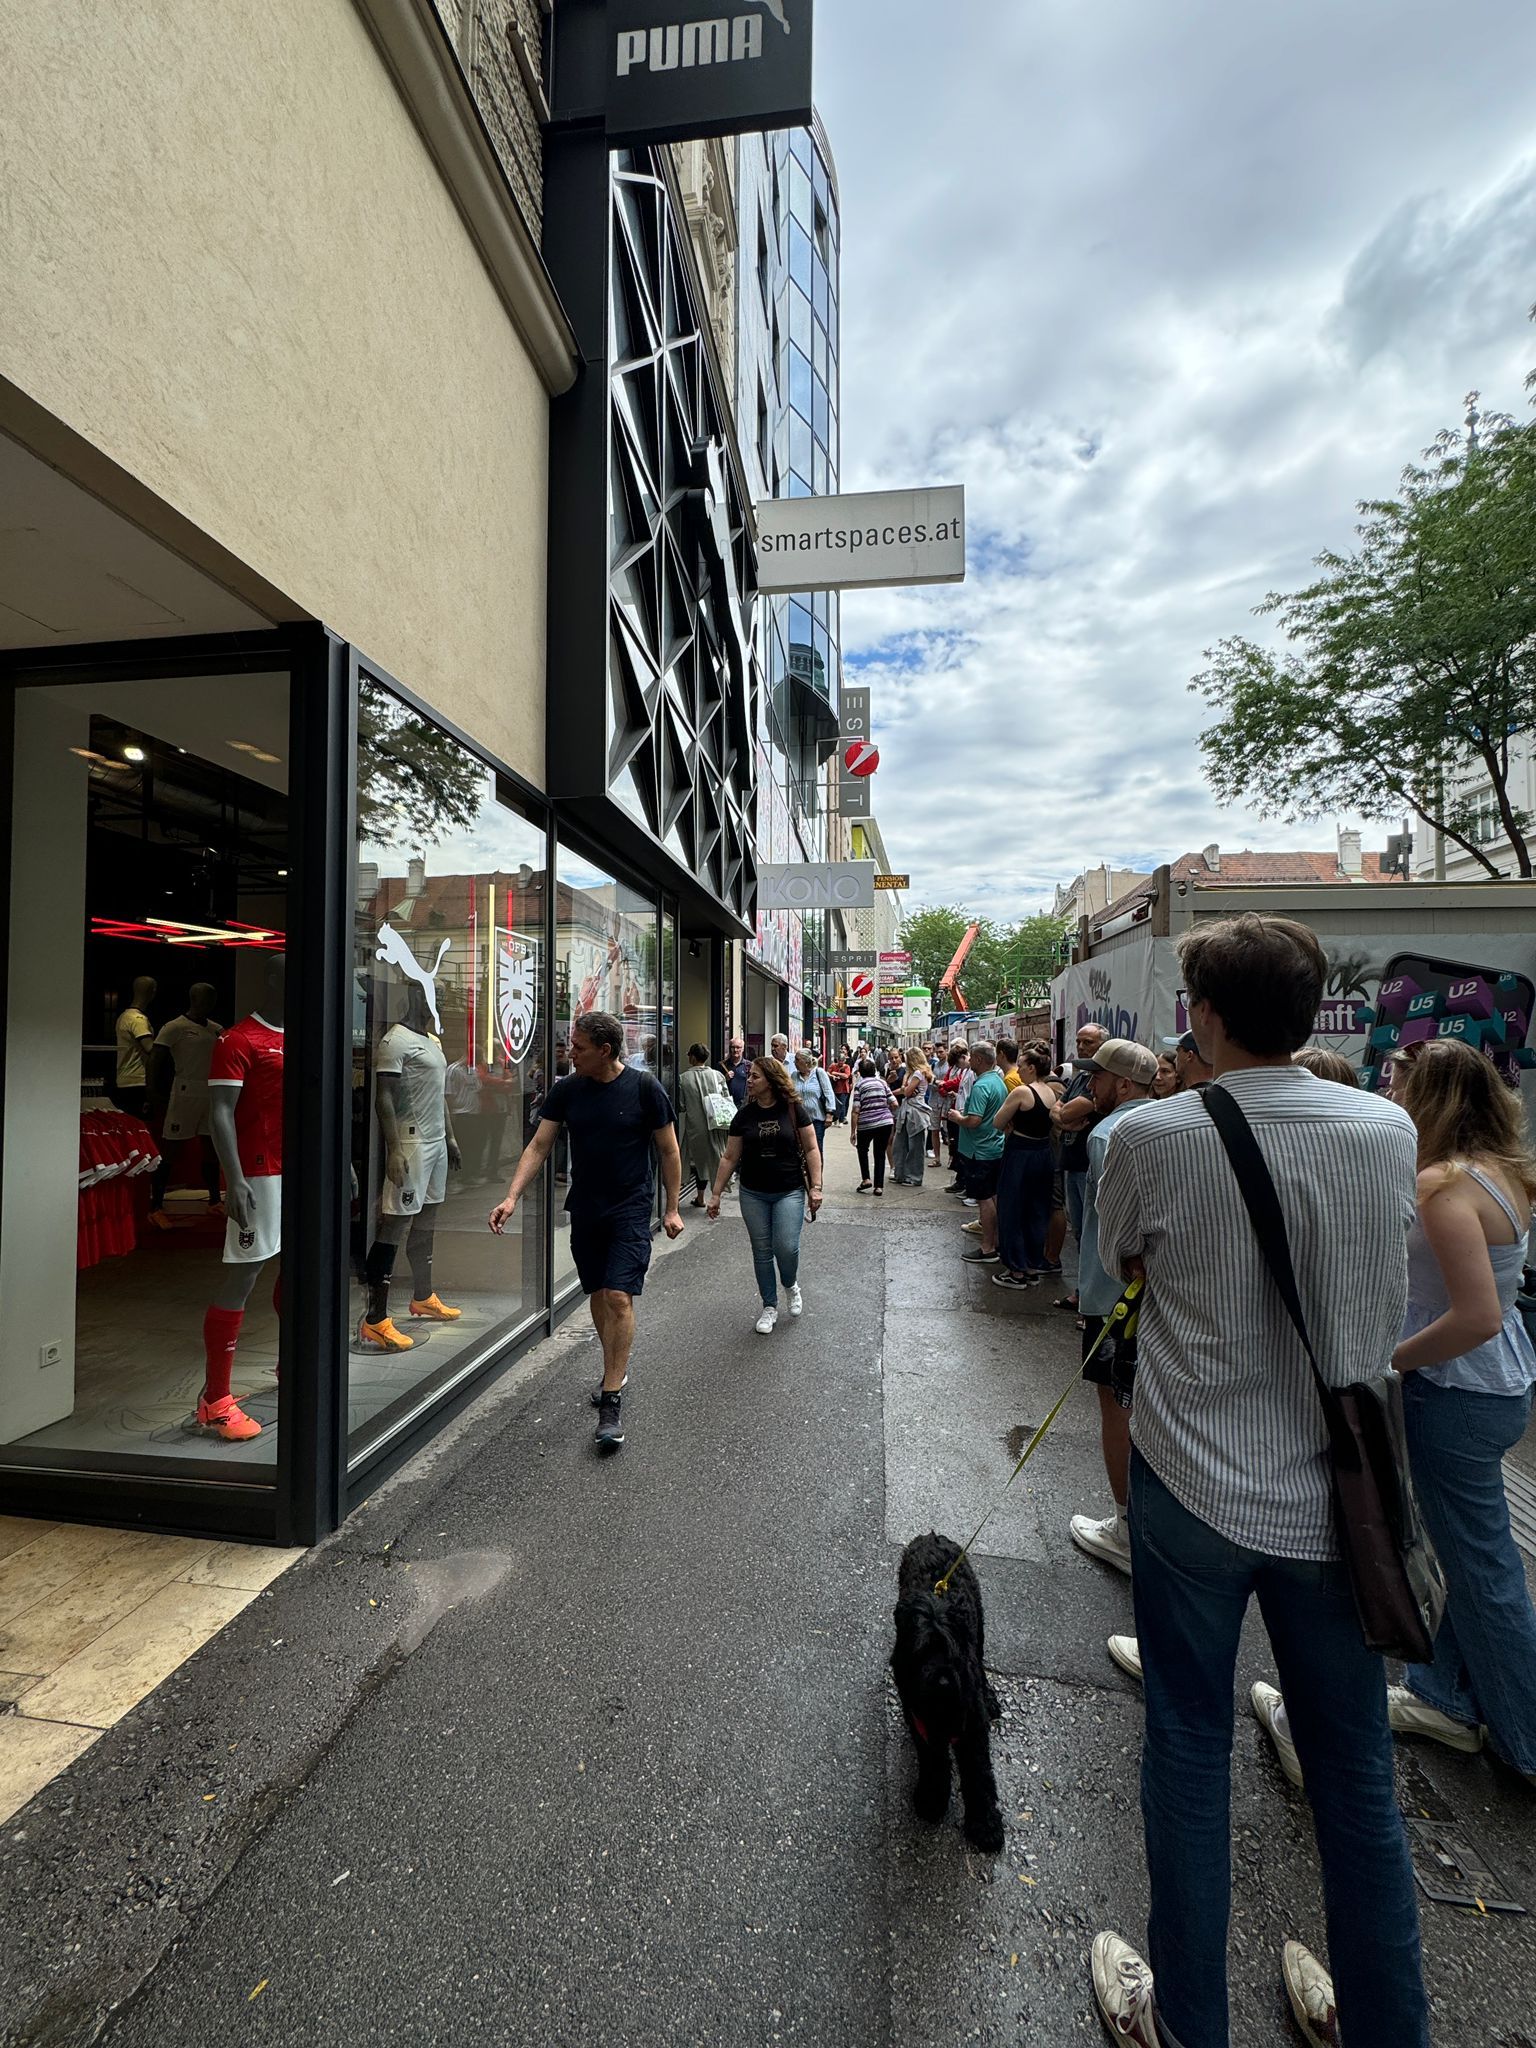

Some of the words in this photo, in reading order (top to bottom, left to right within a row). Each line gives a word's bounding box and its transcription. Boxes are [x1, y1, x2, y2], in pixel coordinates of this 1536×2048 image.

[616, 13, 763, 76] PUMA
[761, 517, 960, 553] smartspaces.at
[1499, 973, 1512, 982] U5
[1380, 980, 1404, 996] U2
[1448, 981, 1478, 999] U2
[1409, 995, 1435, 1012] U5
[1438, 1018, 1466, 1036] U5
